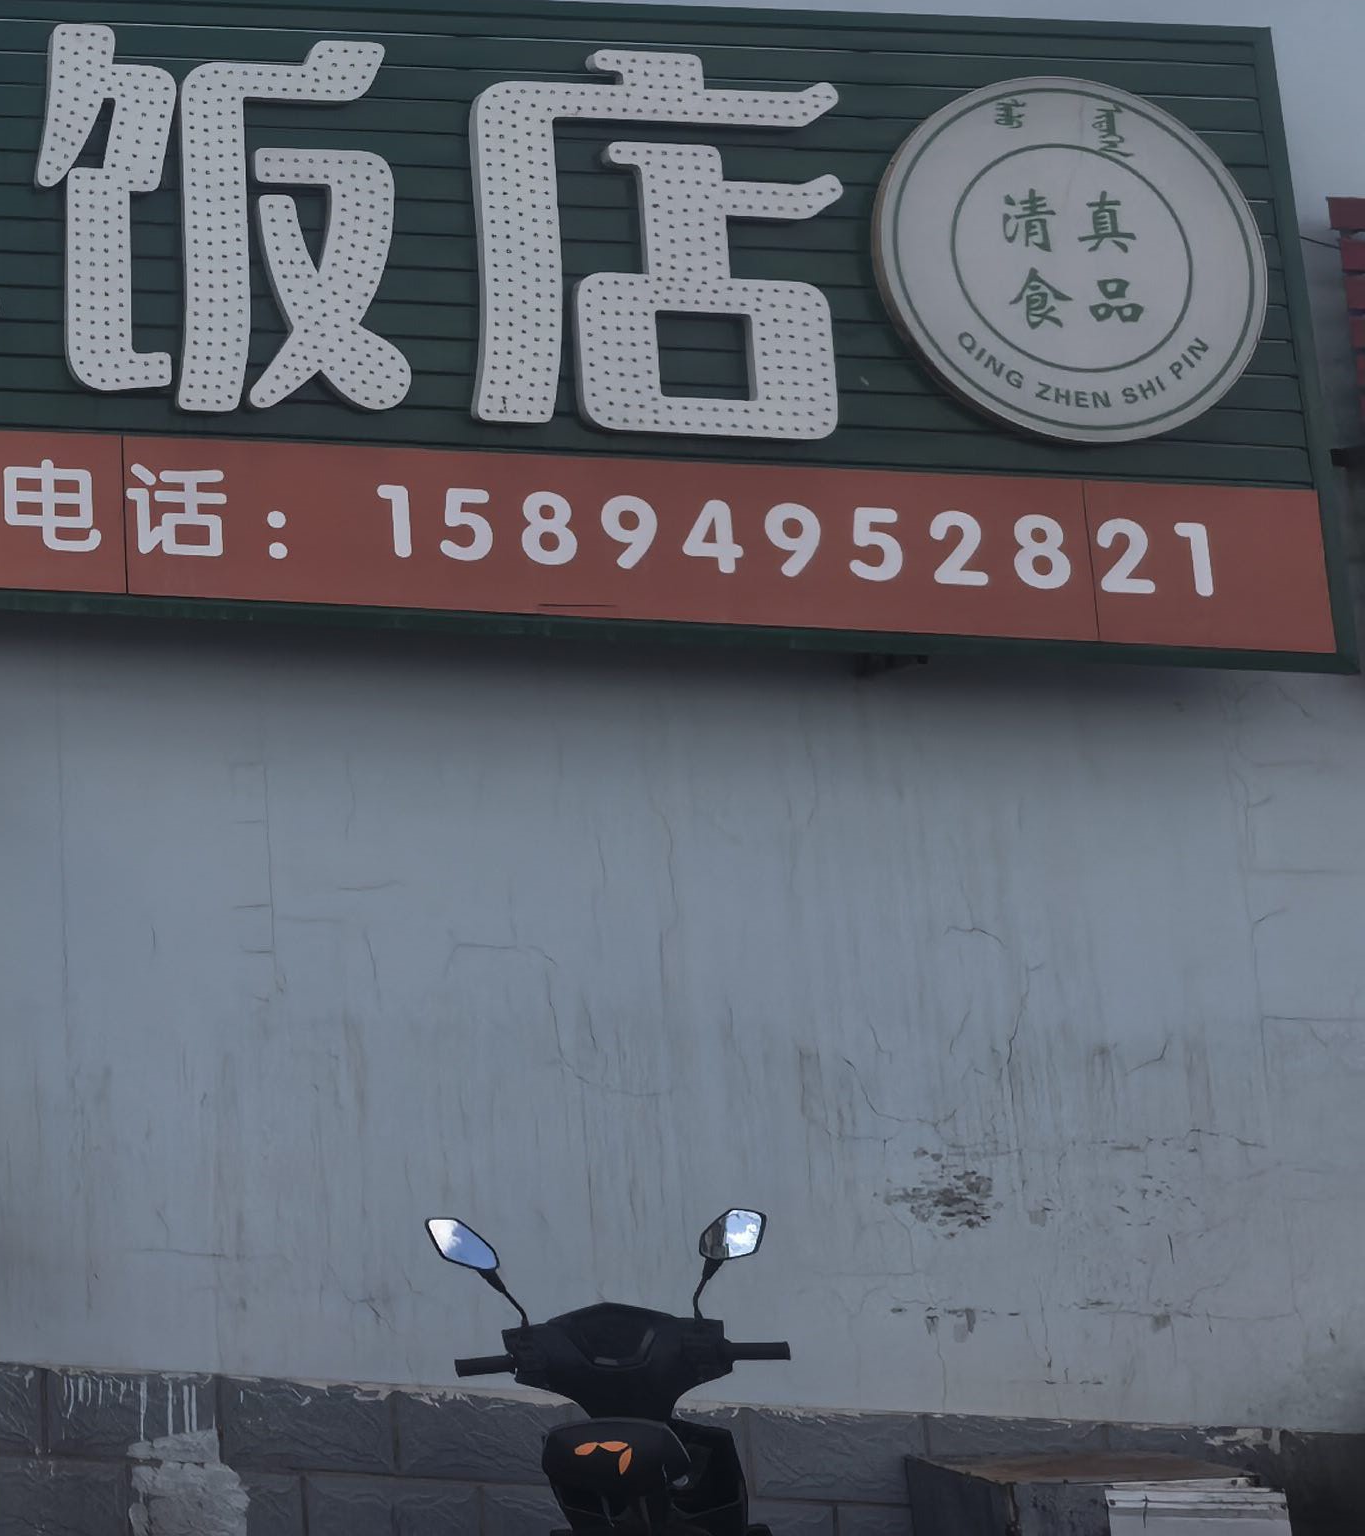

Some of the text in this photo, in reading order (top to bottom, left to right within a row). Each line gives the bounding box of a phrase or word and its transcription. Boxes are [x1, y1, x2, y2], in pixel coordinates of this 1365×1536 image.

[1003, 188, 1136, 253] 清真
[1008, 267, 1144, 330] 食品
[958, 332, 1209, 408] QING ZHEN SHI PIN
[376, 483, 1214, 596] 15894952821
